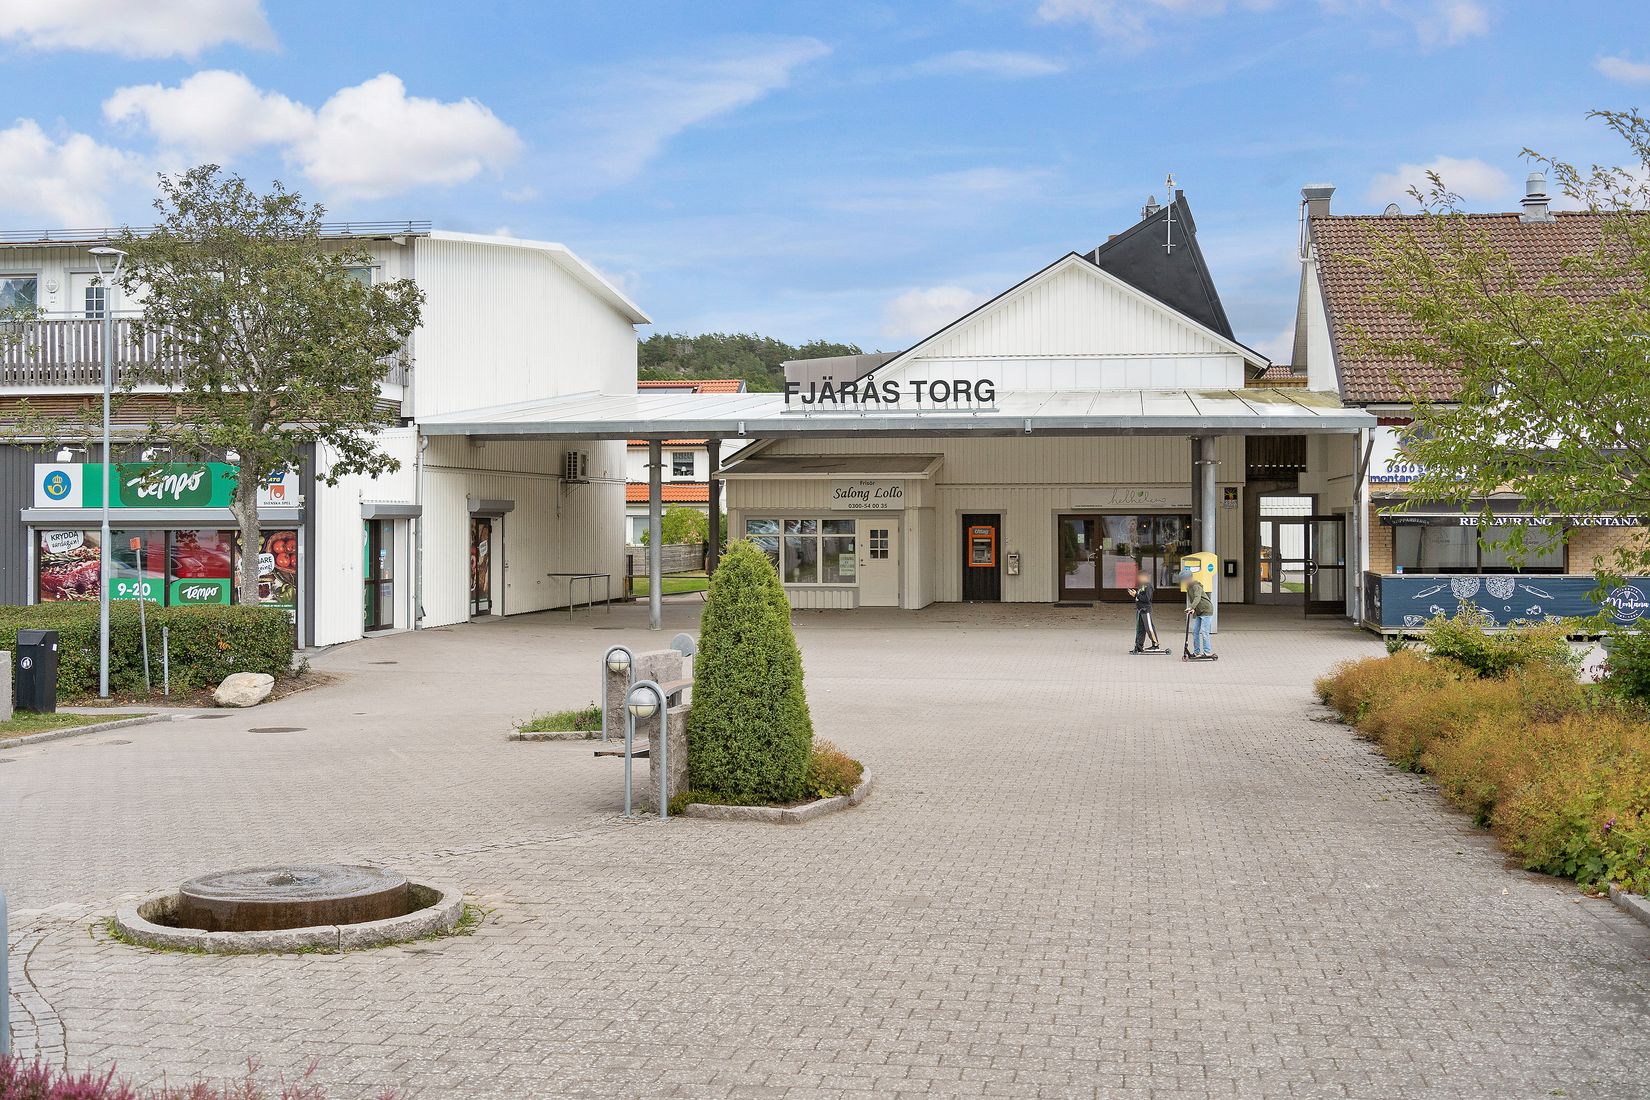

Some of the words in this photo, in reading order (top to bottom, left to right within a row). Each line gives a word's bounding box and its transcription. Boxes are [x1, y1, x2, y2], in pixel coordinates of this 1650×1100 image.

[785, 374, 900, 404] FJÄRÅS
[909, 379, 995, 403] TORG
[127, 469, 206, 500] tempo
[833, 486, 870, 502] Salong
[874, 486, 903, 498] Lollo
[50, 531, 79, 541] KRYDDA
[117, 582, 151, 596] 9-20
[181, 585, 219, 600] tempo
